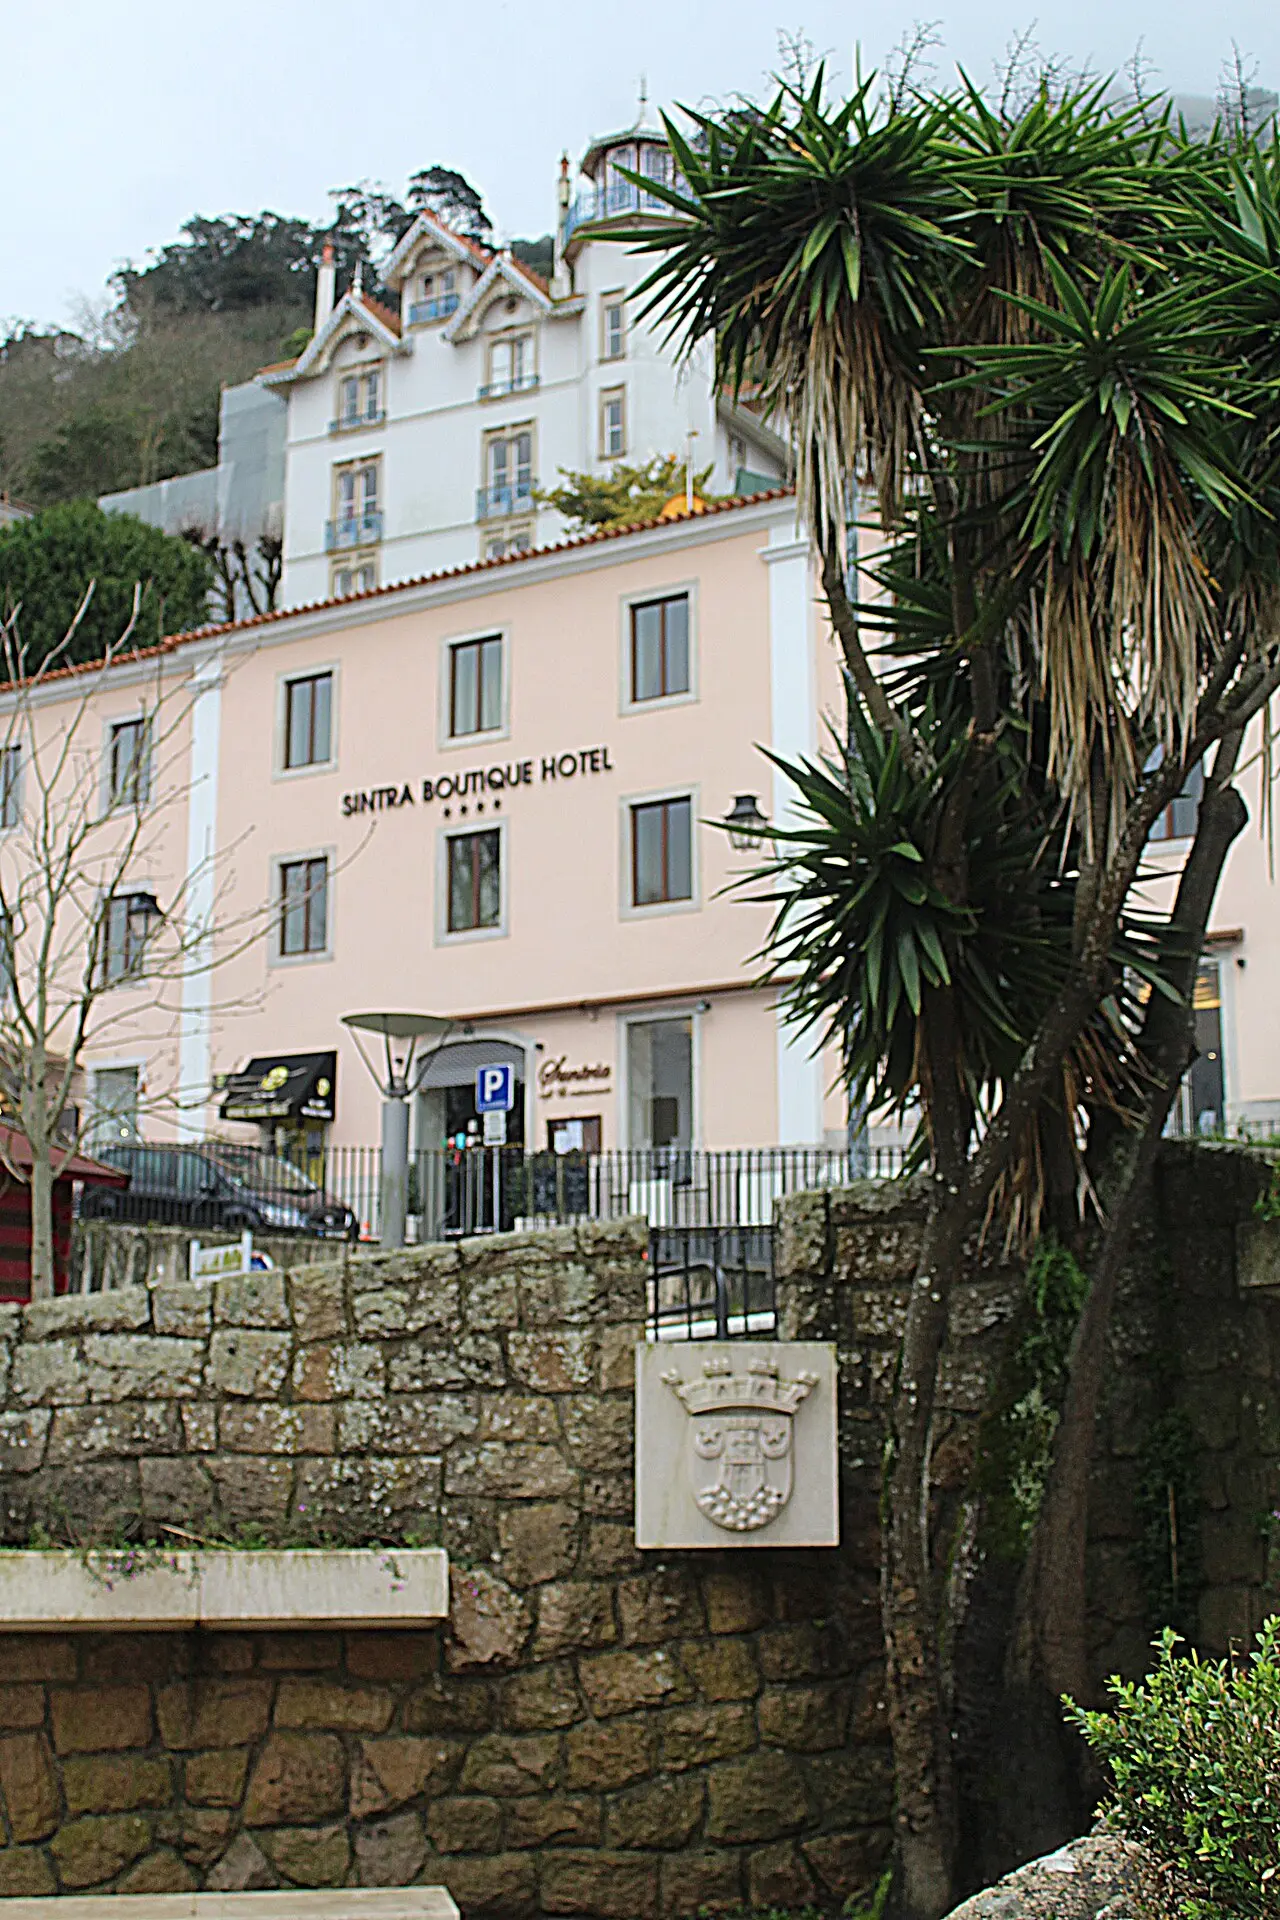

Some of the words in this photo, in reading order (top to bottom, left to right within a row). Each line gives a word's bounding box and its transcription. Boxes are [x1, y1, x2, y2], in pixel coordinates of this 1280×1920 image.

[342, 784, 414, 816] SINTRA
[423, 761, 532, 802] BOUTIQUE
[542, 747, 612, 780] HOTEL
[485, 1070, 504, 1102] P
